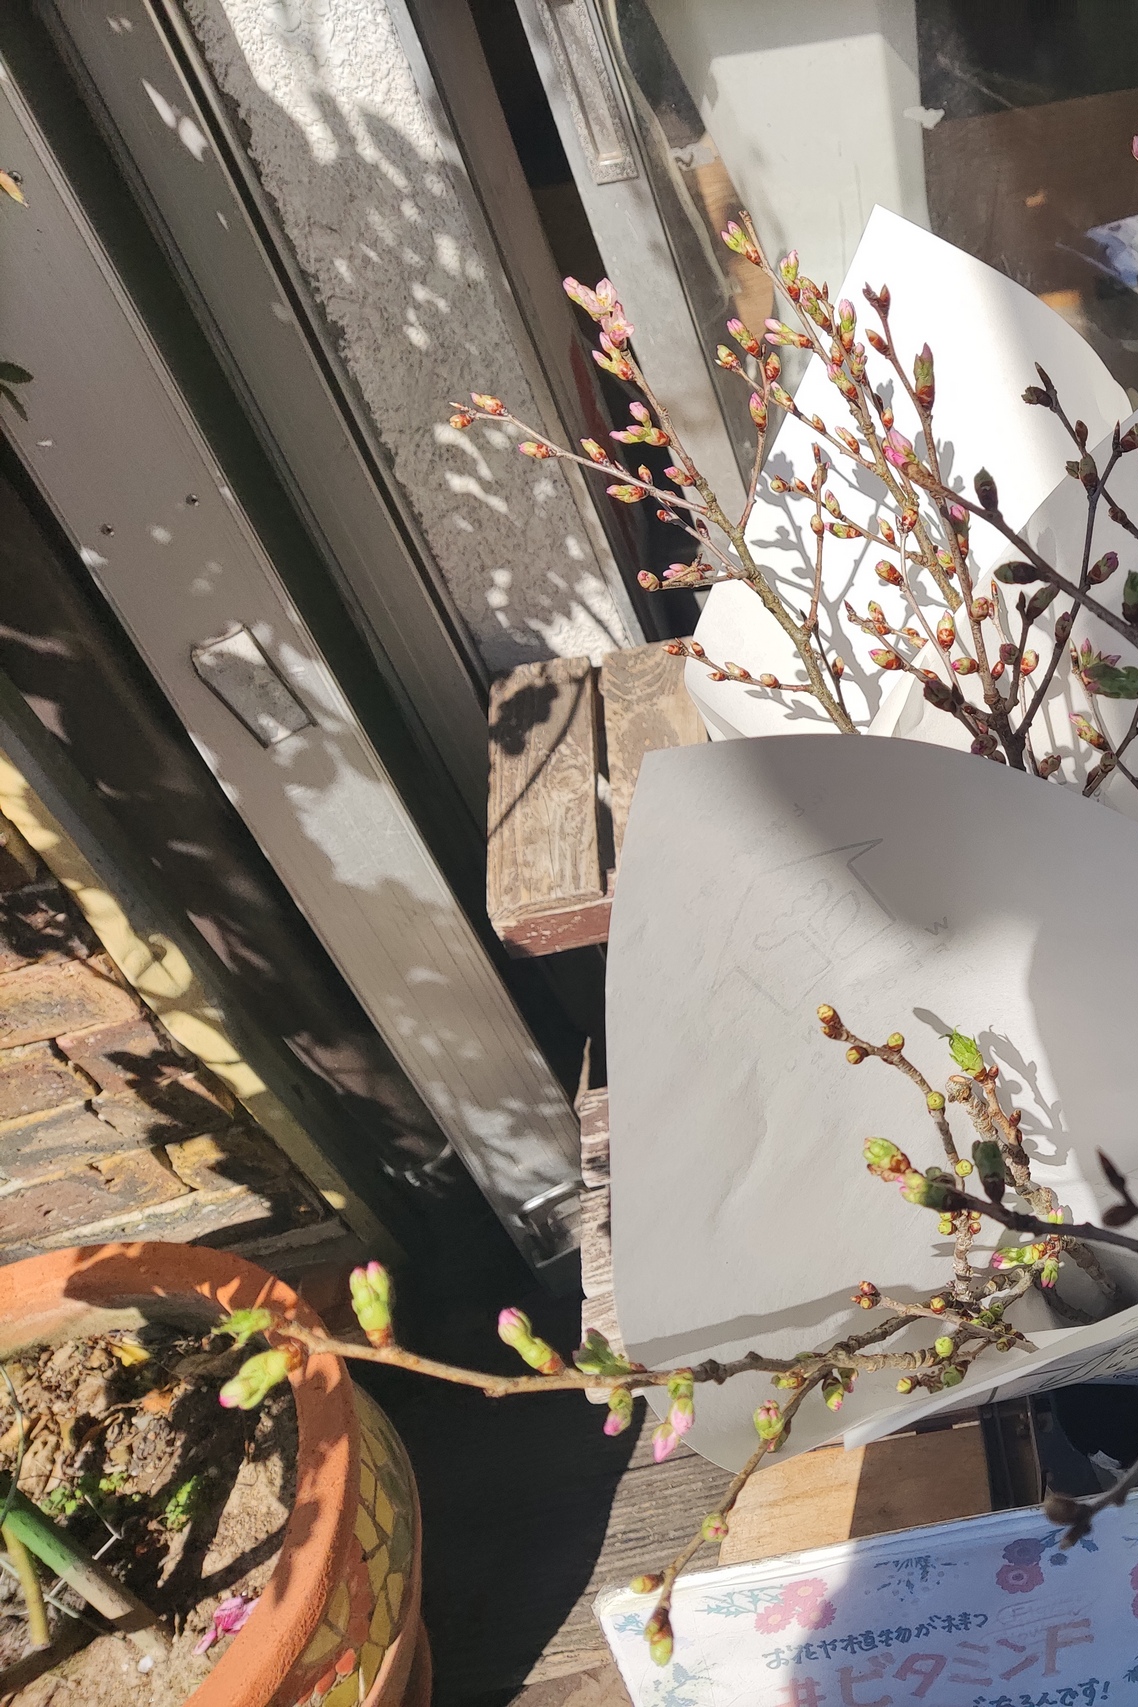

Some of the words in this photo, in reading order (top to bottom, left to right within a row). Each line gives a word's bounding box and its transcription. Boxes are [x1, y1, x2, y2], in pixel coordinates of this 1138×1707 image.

[761, 1611, 989, 1669] お花や植物が持つ
